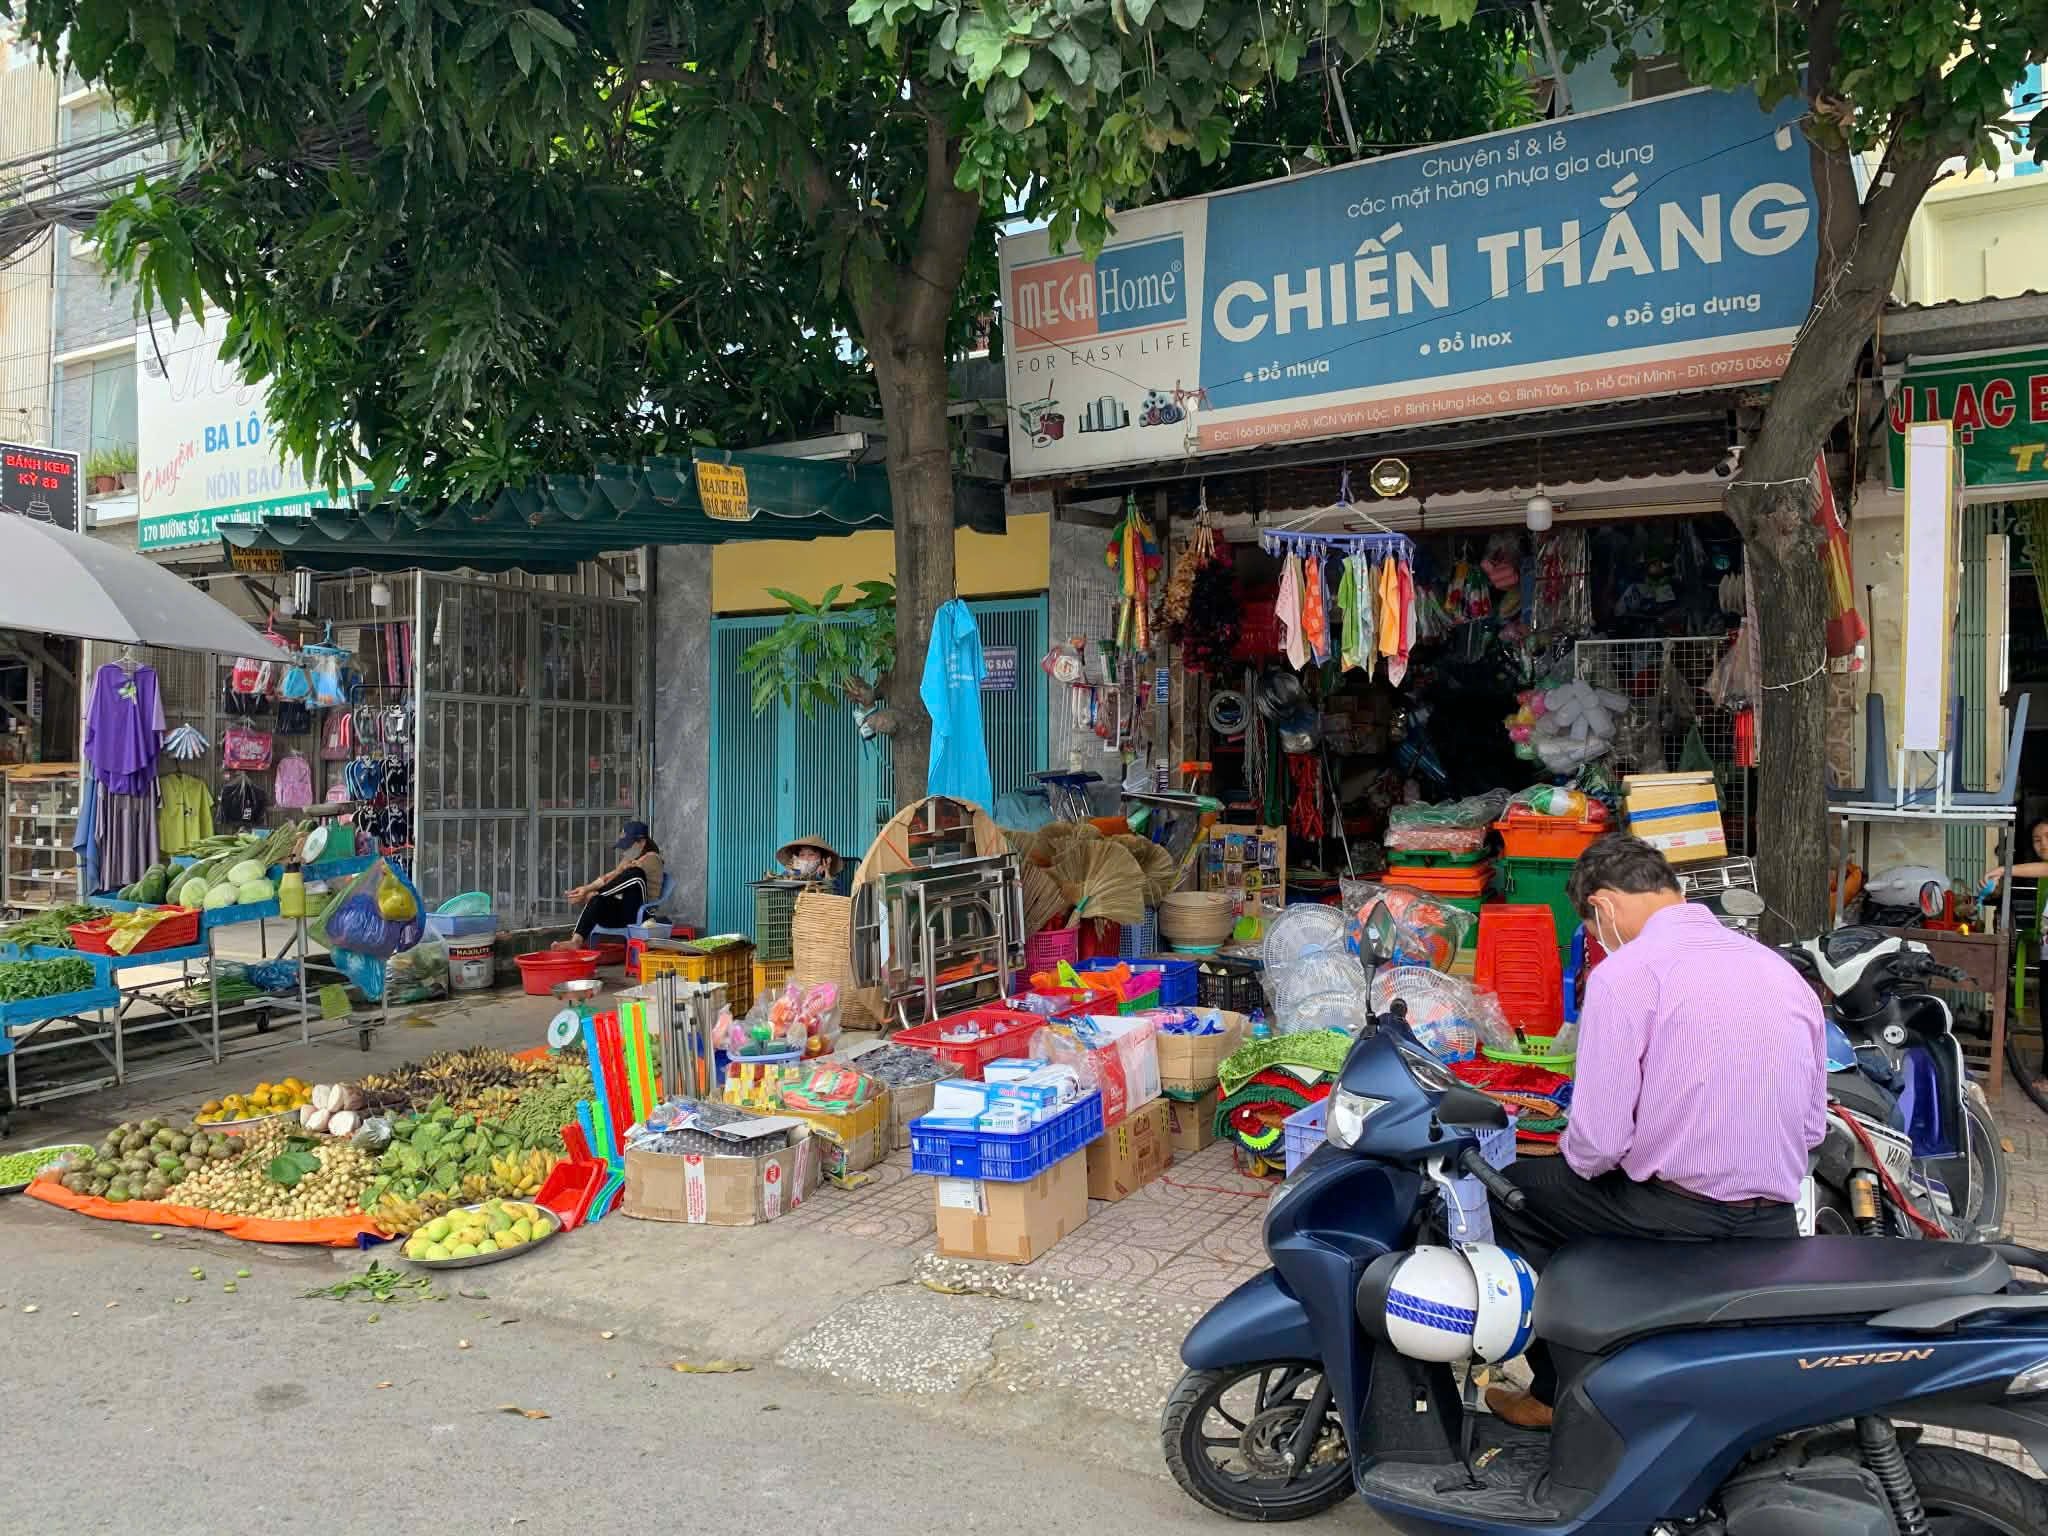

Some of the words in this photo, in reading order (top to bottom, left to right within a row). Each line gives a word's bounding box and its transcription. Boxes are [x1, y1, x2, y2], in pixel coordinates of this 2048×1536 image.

[1422, 149, 1501, 178] Chuyên
[1526, 138, 1542, 157] &
[1548, 130, 1567, 153] lẻ
[1347, 196, 1386, 218] các
[1391, 186, 1431, 209] mặt
[1436, 177, 1489, 201] hàng
[1495, 164, 1549, 189] nhựa
[1555, 155, 1589, 182] gia
[1595, 143, 1655, 170] dụng
[1213, 222, 1449, 343] CHIẾN
[1478, 171, 1810, 299] THẮNG
[1018, 272, 1095, 330] MEGA
[1624, 302, 1654, 326] Đồ
[1661, 302, 1696, 325] gia
[1703, 293, 1761, 316] dụng
[1017, 355, 1056, 376] FOR
[1071, 343, 1124, 366] EASY
[1141, 332, 1193, 355] LIFE
[1438, 332, 1465, 354] Đồ
[1471, 329, 1512, 350] Inox
[1257, 360, 1281, 382] Đồ
[1286, 359, 1330, 379] nhựa
[1314, 415, 1337, 427] KCN
[1643, 369, 1677, 385] Minh
[1711, 358, 1744, 375] 0975
[205, 423, 229, 453] BA
[236, 411, 261, 447] LÔ
[44, 460, 71, 475] KEM
[144, 525, 158, 541] 170
[1798, 1348, 1936, 1370] VISION
